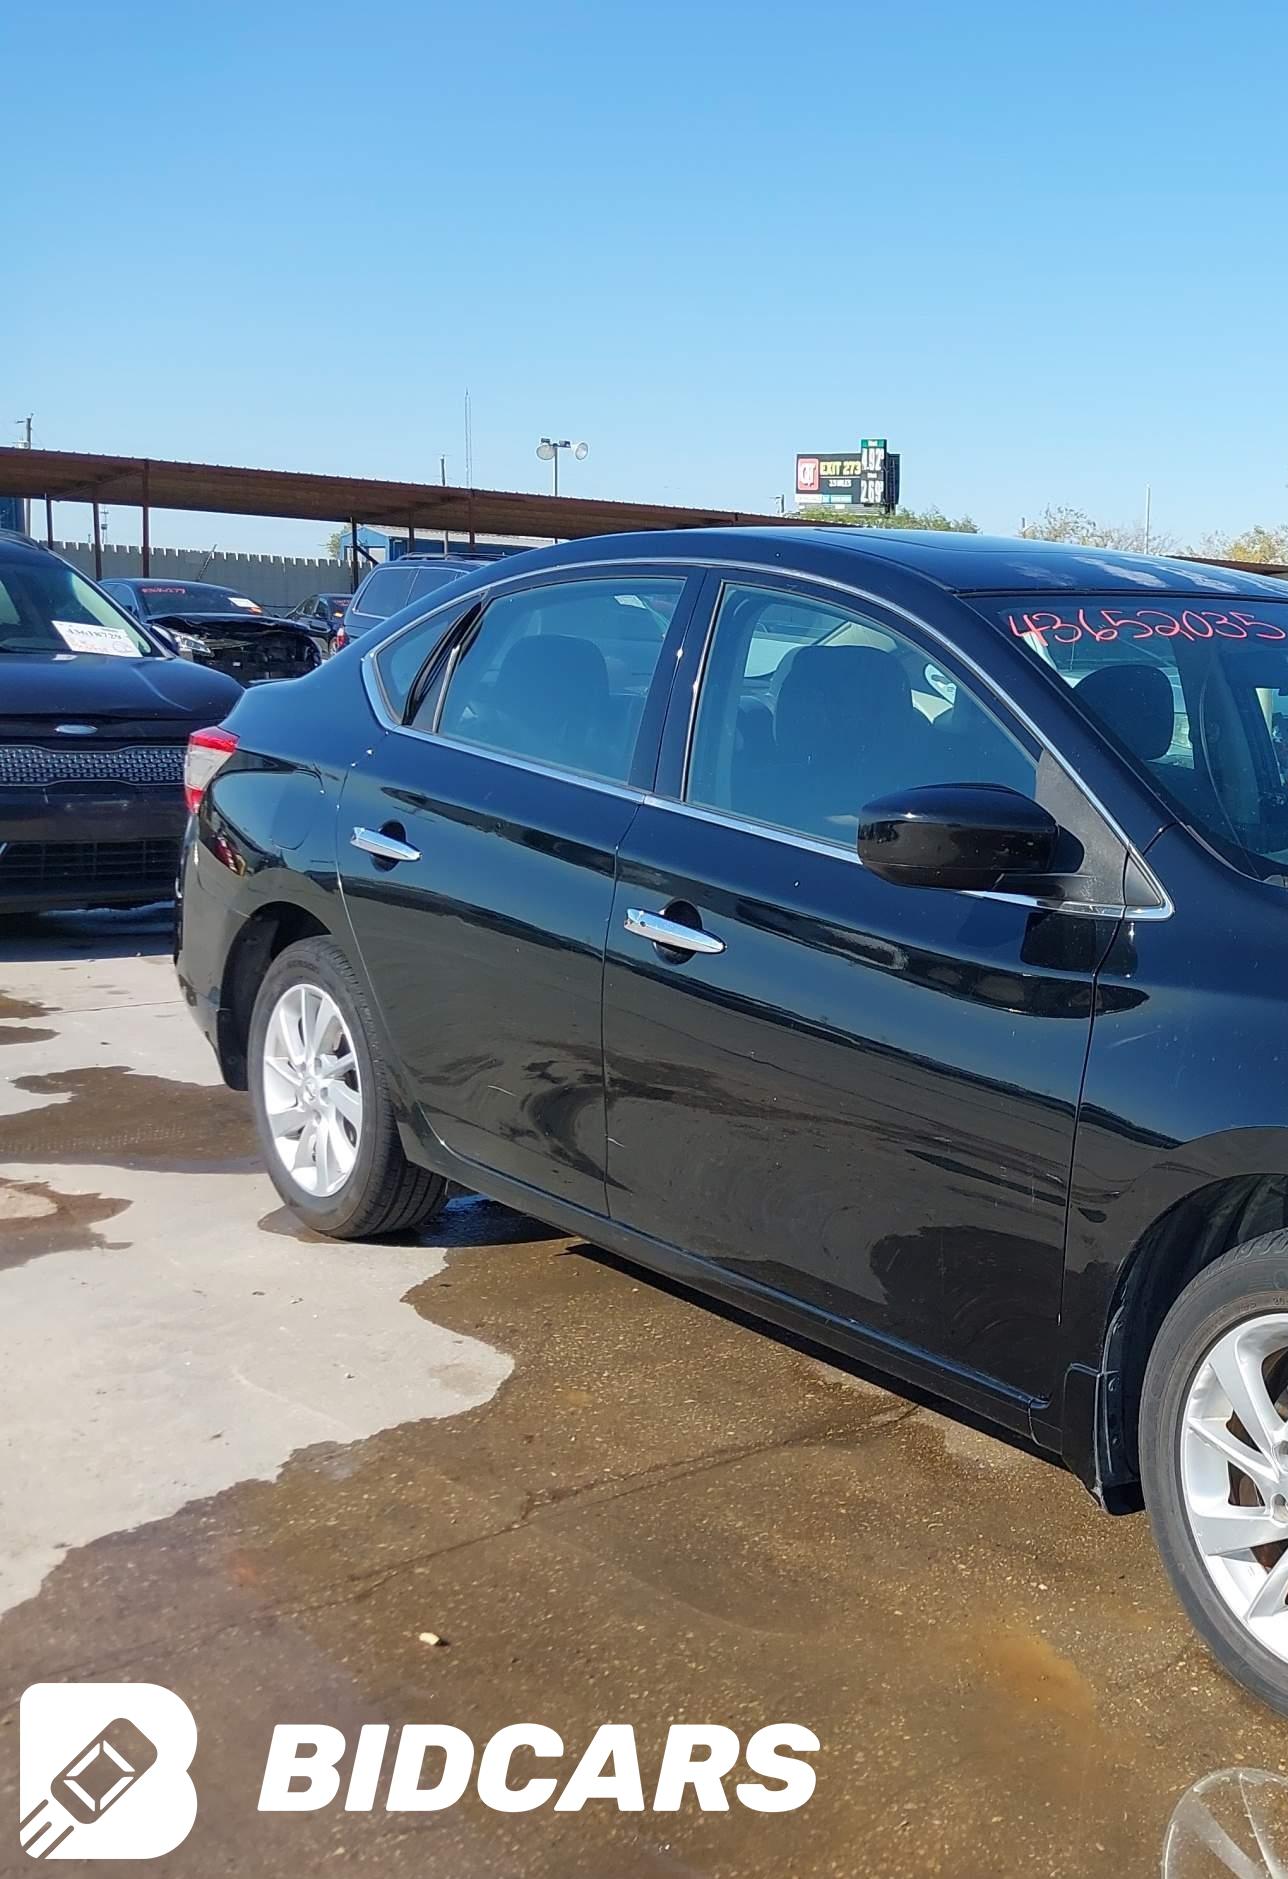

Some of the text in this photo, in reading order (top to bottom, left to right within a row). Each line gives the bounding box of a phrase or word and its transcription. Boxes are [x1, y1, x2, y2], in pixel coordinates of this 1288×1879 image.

[820, 461, 861, 476] EXIT 273
[1008, 608, 1287, 647] 43652035
